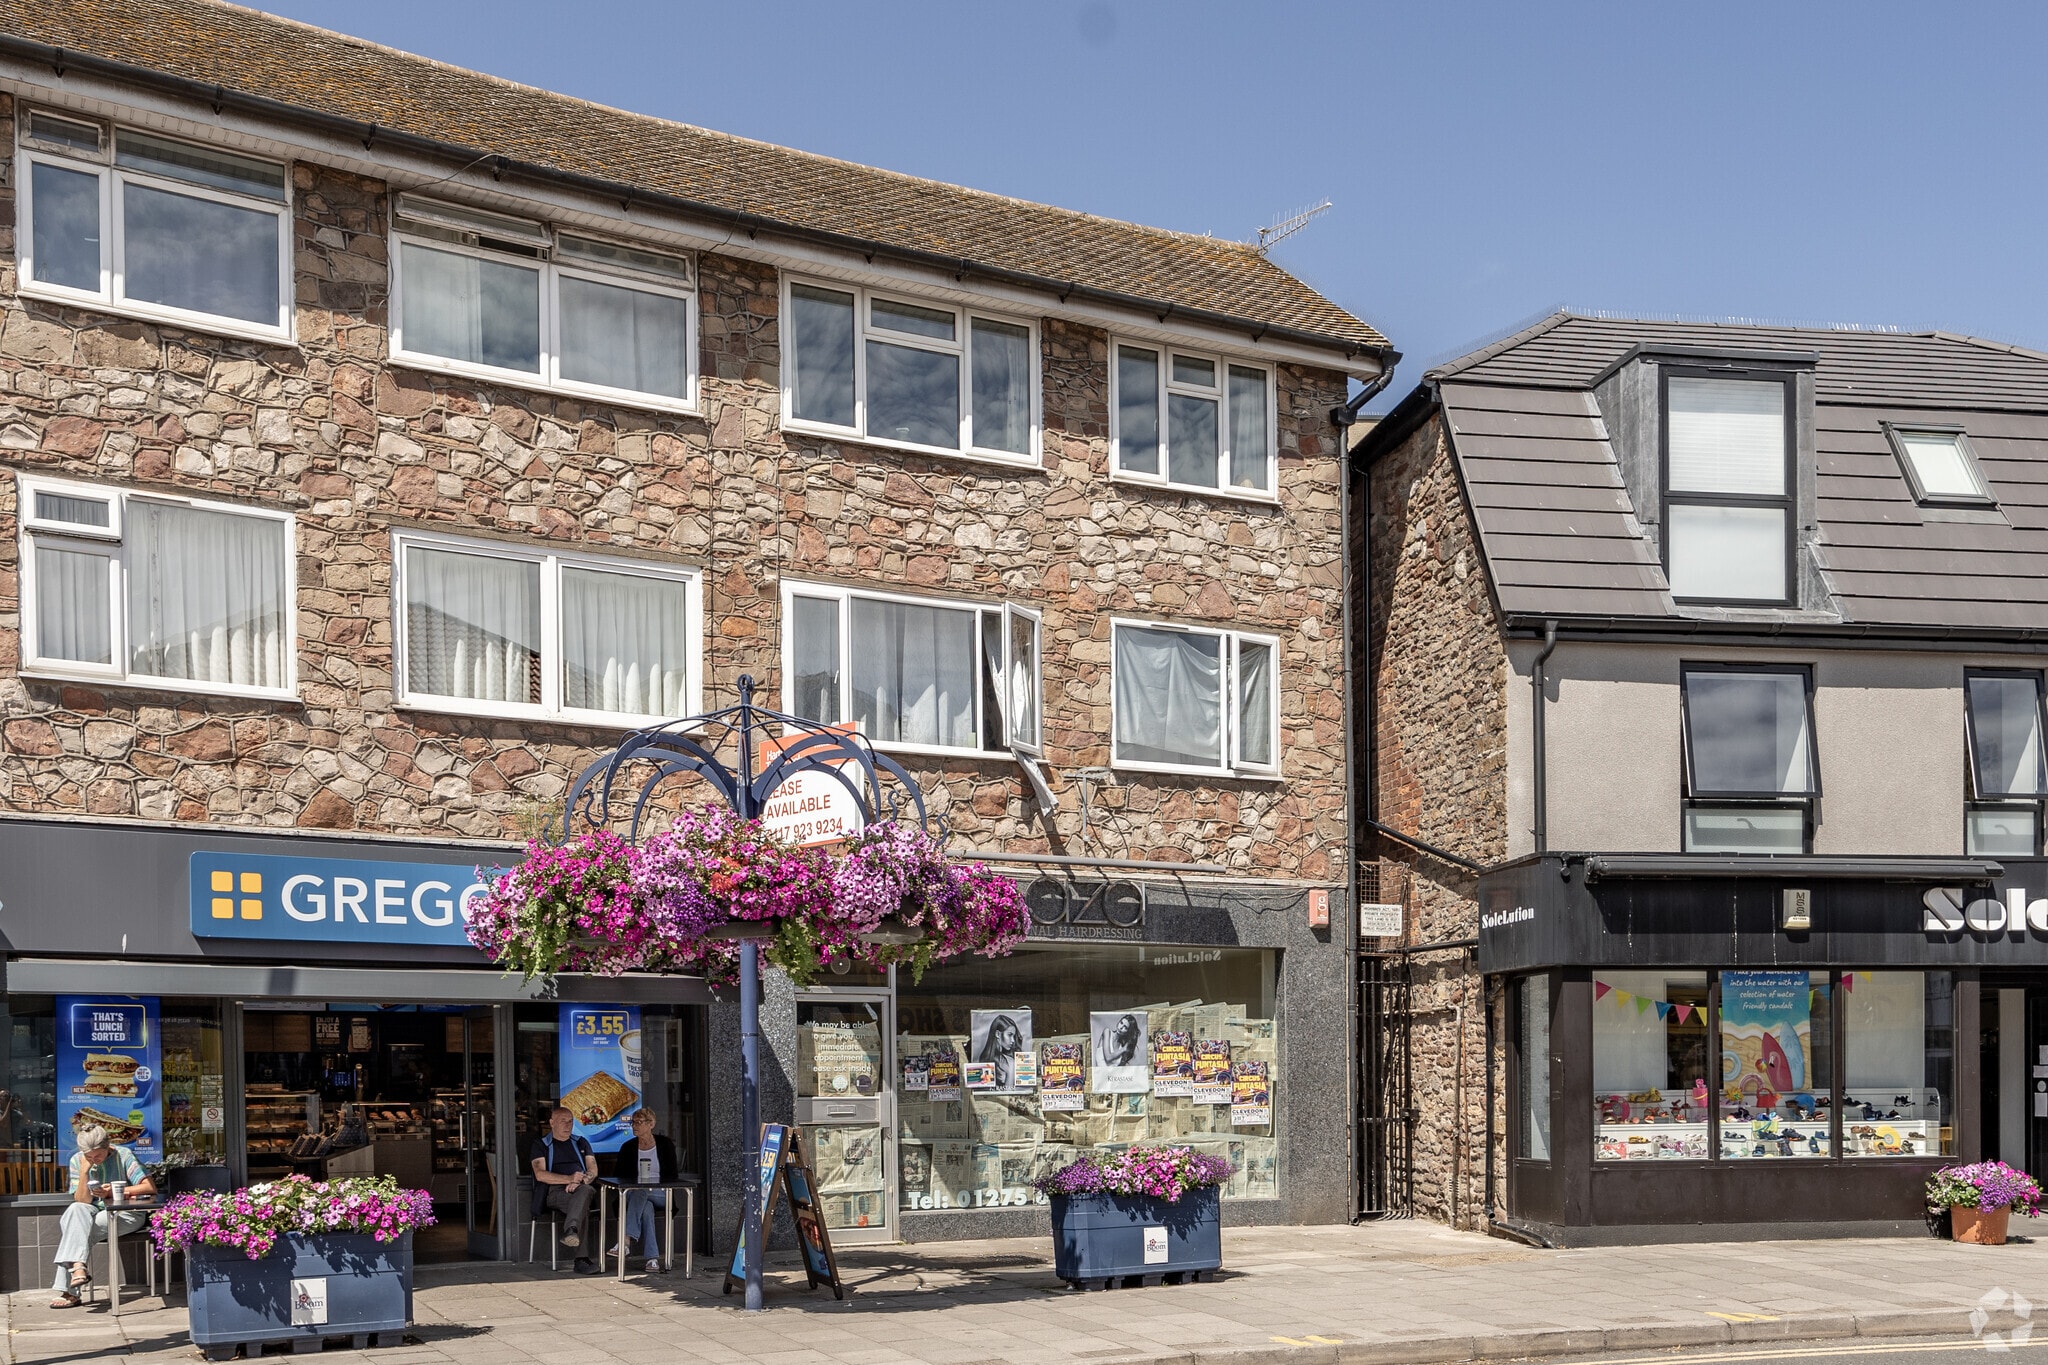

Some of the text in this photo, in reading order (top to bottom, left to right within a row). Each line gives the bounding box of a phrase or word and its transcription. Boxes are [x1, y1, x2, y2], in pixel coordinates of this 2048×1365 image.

[766, 794, 831, 819] AVAILABLE
[793, 823, 813, 841] 923
[815, 816, 843, 836] 9234
[281, 873, 494, 928] GREG
[1059, 926, 1143, 939] HAIRDRESSING
[1740, 990, 1767, 998] selection
[1768, 990, 1777, 999] of
[1742, 1002, 1793, 1011] friendly sandals
[92, 1012, 124, 1022] THAT'S
[93, 1022, 123, 1032] LUNCH
[316, 1023, 340, 1033] FREE
[577, 1016, 624, 1035] £3.55
[804, 1021, 868, 1030] We may be able
[91, 1032, 126, 1042] SORTED
[837, 1033, 854, 1041] you
[813, 1055, 864, 1063] appointment
[1156, 1052, 1191, 1062] FUNTASIA
[833, 1064, 847, 1072] ask
[1195, 1060, 1229, 1070] FUNTASIA
[1044, 1066, 1081, 1076] FUNTASIA
[1233, 1082, 1267, 1092] FUNTASIA
[908, 1189, 949, 1210] Tel:
[957, 1188, 1028, 1208] 01275
